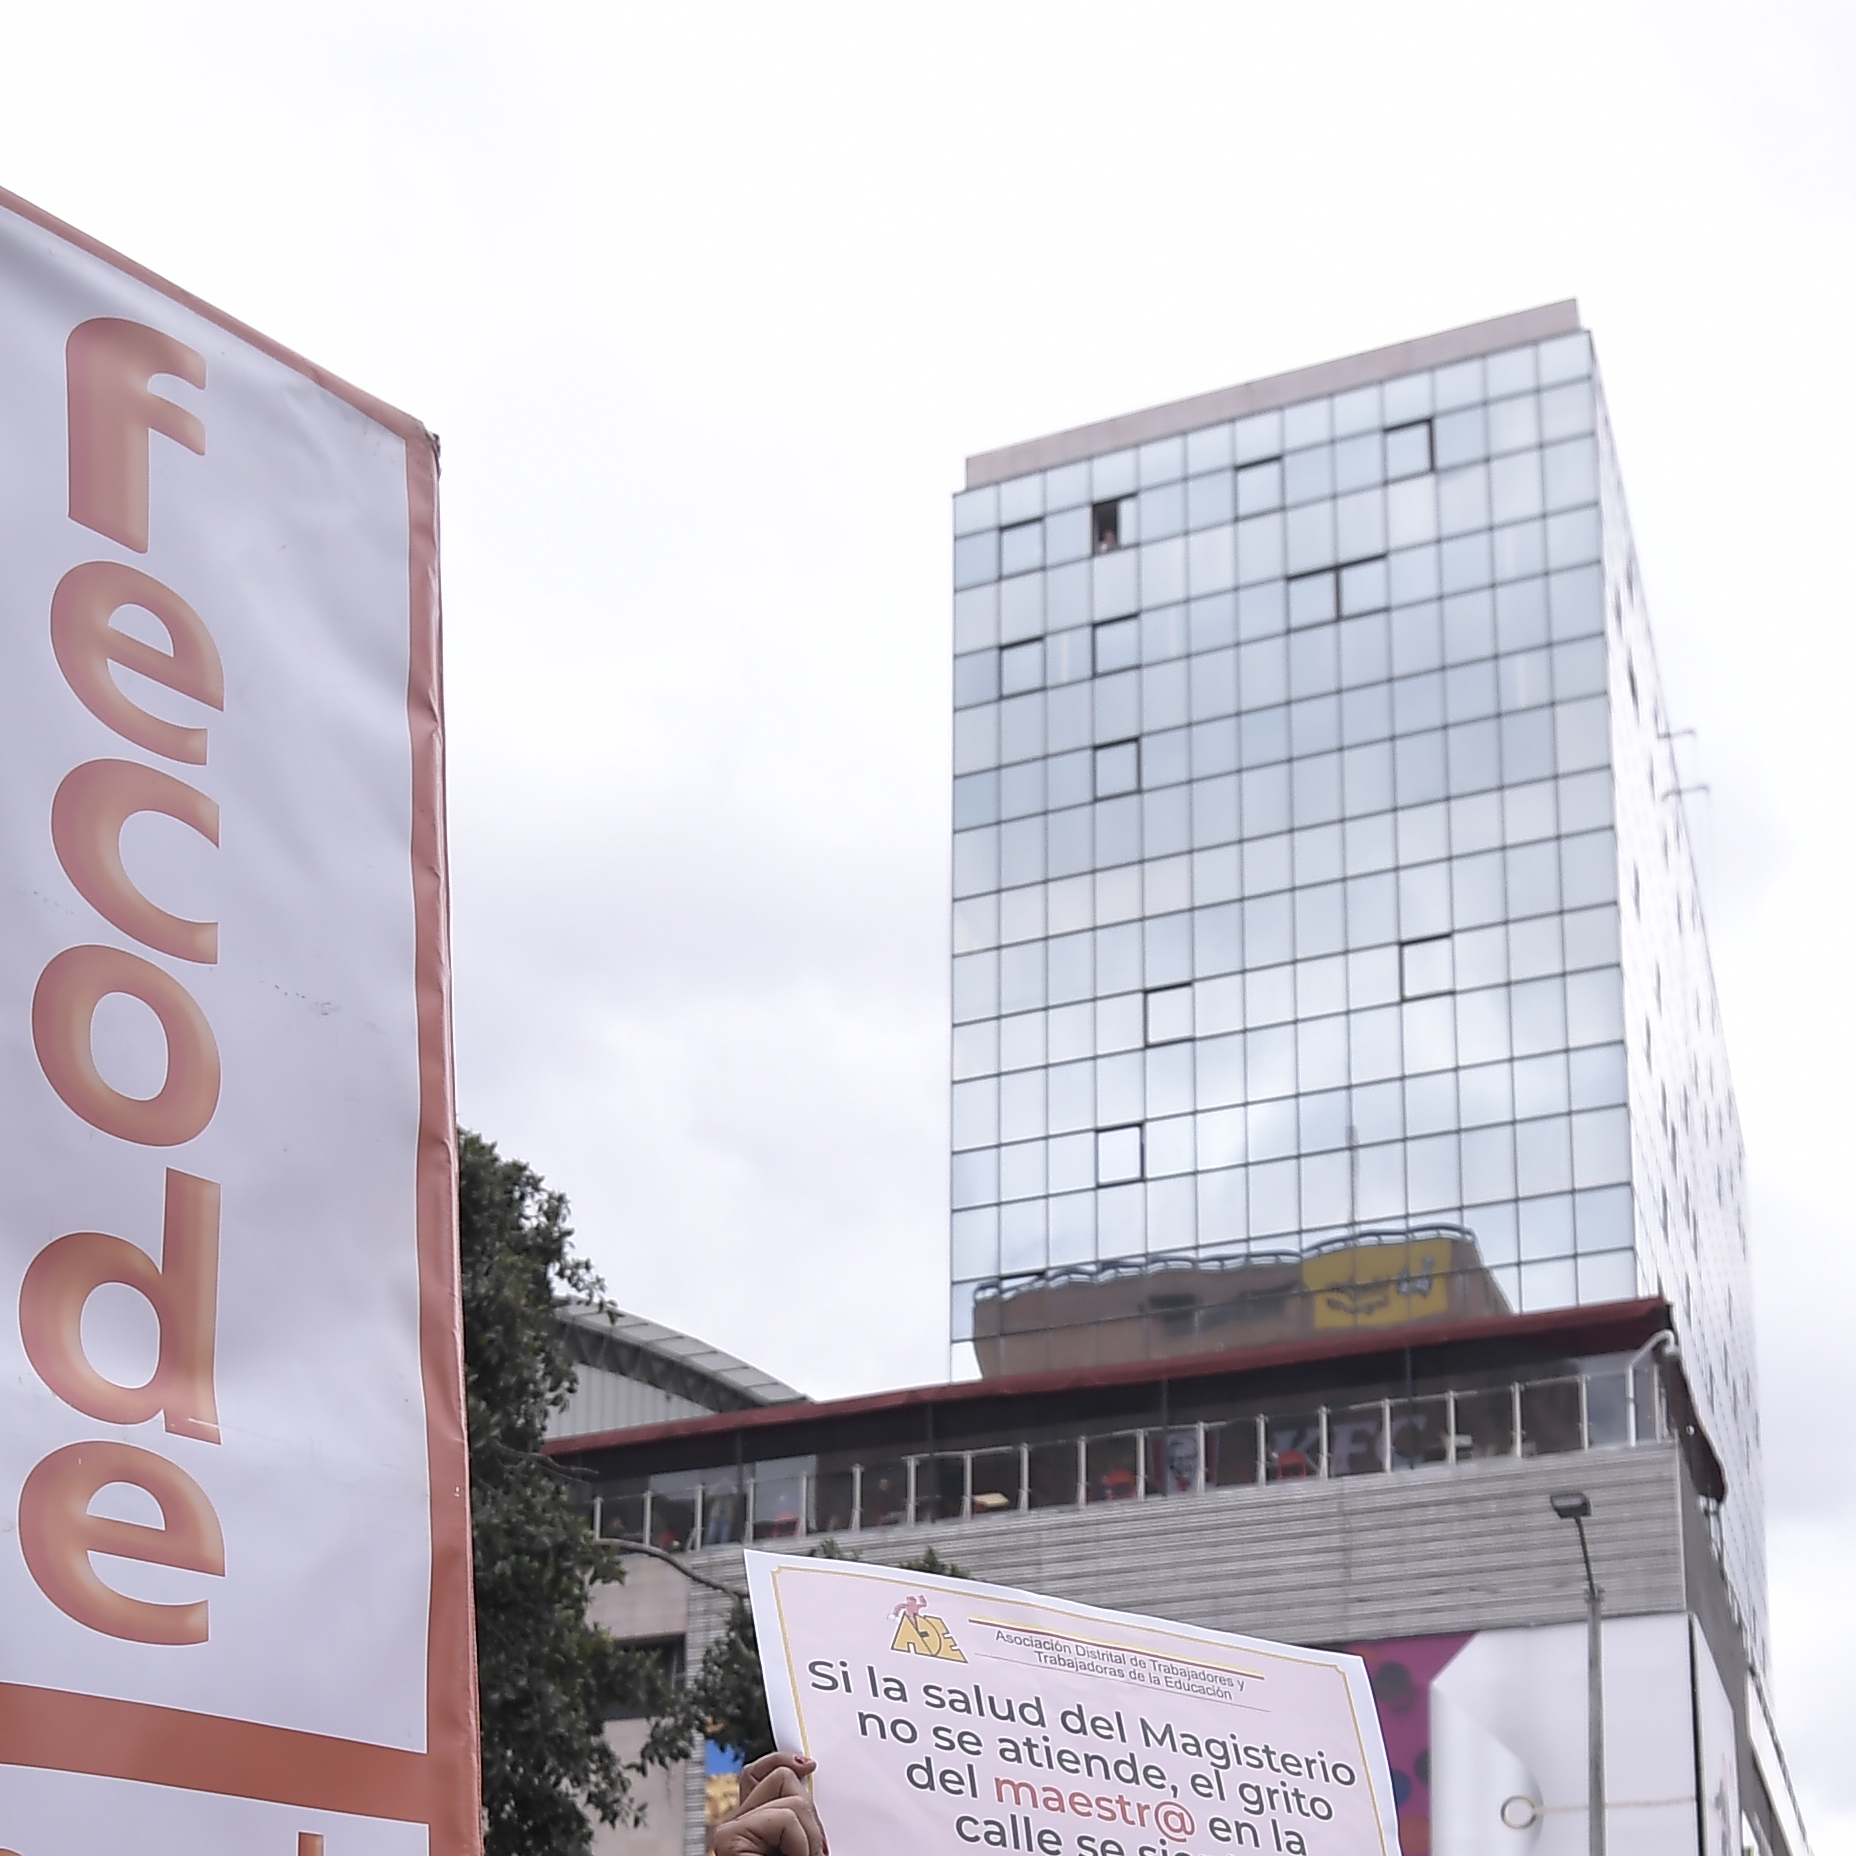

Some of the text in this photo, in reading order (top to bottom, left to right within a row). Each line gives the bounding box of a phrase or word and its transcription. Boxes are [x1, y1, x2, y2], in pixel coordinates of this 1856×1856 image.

[17, 315, 227, 1646] fecode
[995, 1629, 1245, 1692] Asociación Distrital de Trabajadores y
[1034, 1651, 1233, 1701] Trabajadoras de la Educación
[808, 1660, 1356, 1786] Si la salud del Magisterio
[857, 1710, 1333, 1821] no se atiende, el grito
[906, 1756, 1307, 1856] del maestr@ en la
[955, 1813, 1063, 1856] calle
